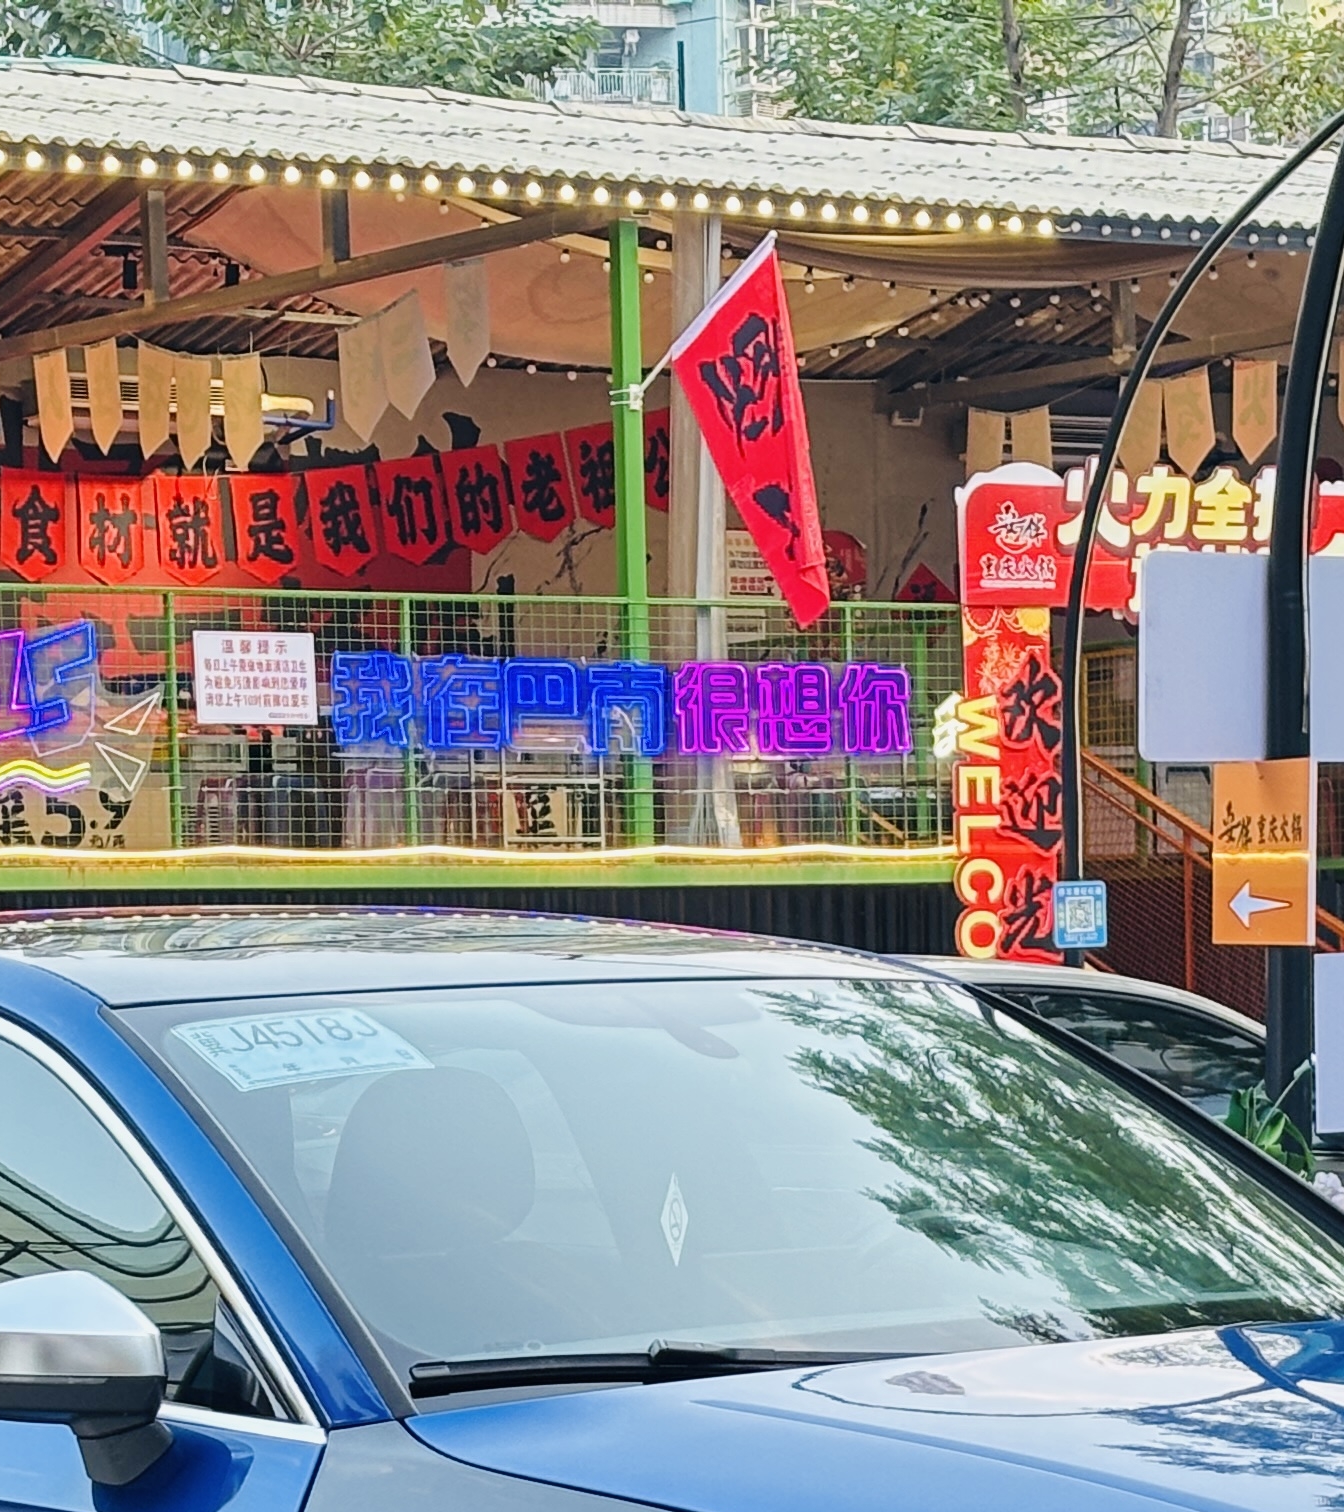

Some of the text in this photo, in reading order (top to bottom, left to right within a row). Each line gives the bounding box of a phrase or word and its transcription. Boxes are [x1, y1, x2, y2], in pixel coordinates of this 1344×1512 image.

[222, 639, 288, 655] 温馨提示
[332, 649, 912, 756] 我在巴南很想你
